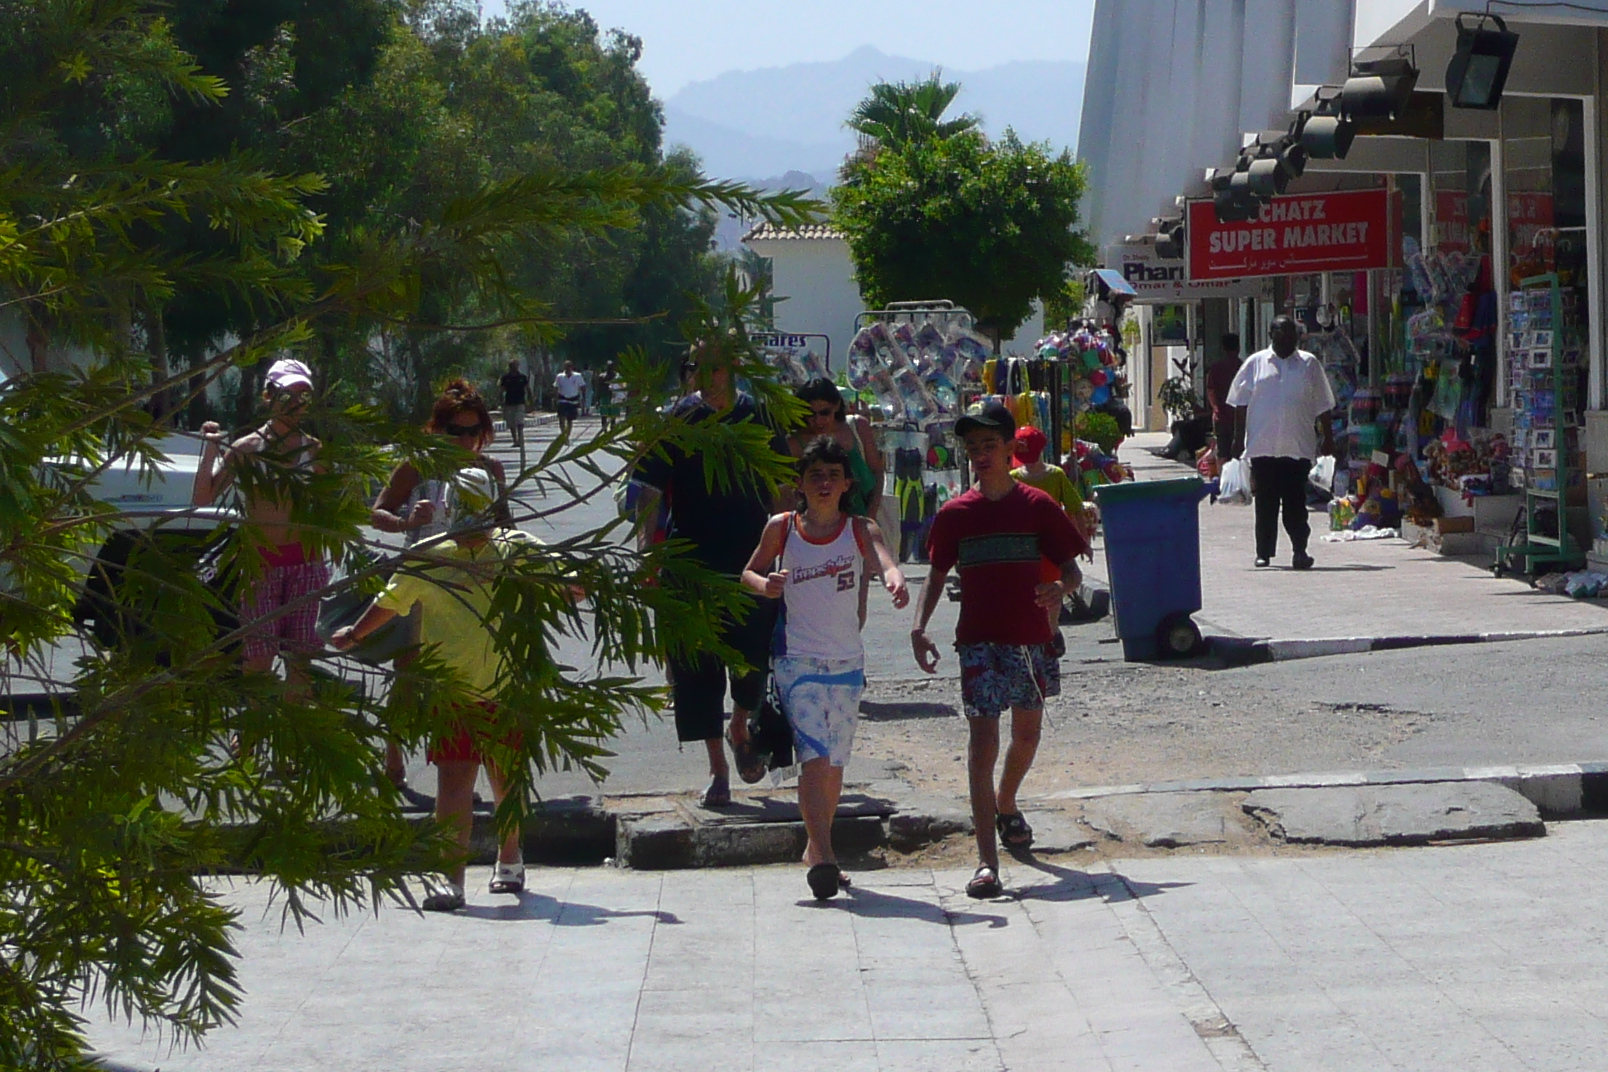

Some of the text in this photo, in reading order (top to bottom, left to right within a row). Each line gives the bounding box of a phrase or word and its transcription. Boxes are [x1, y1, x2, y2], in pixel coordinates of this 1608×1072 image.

[1246, 199, 1326, 224] CHATZ
[1209, 221, 1368, 253] SUPER MARKET
[1123, 262, 1184, 280] Phar
[837, 571, 855, 591] 53
